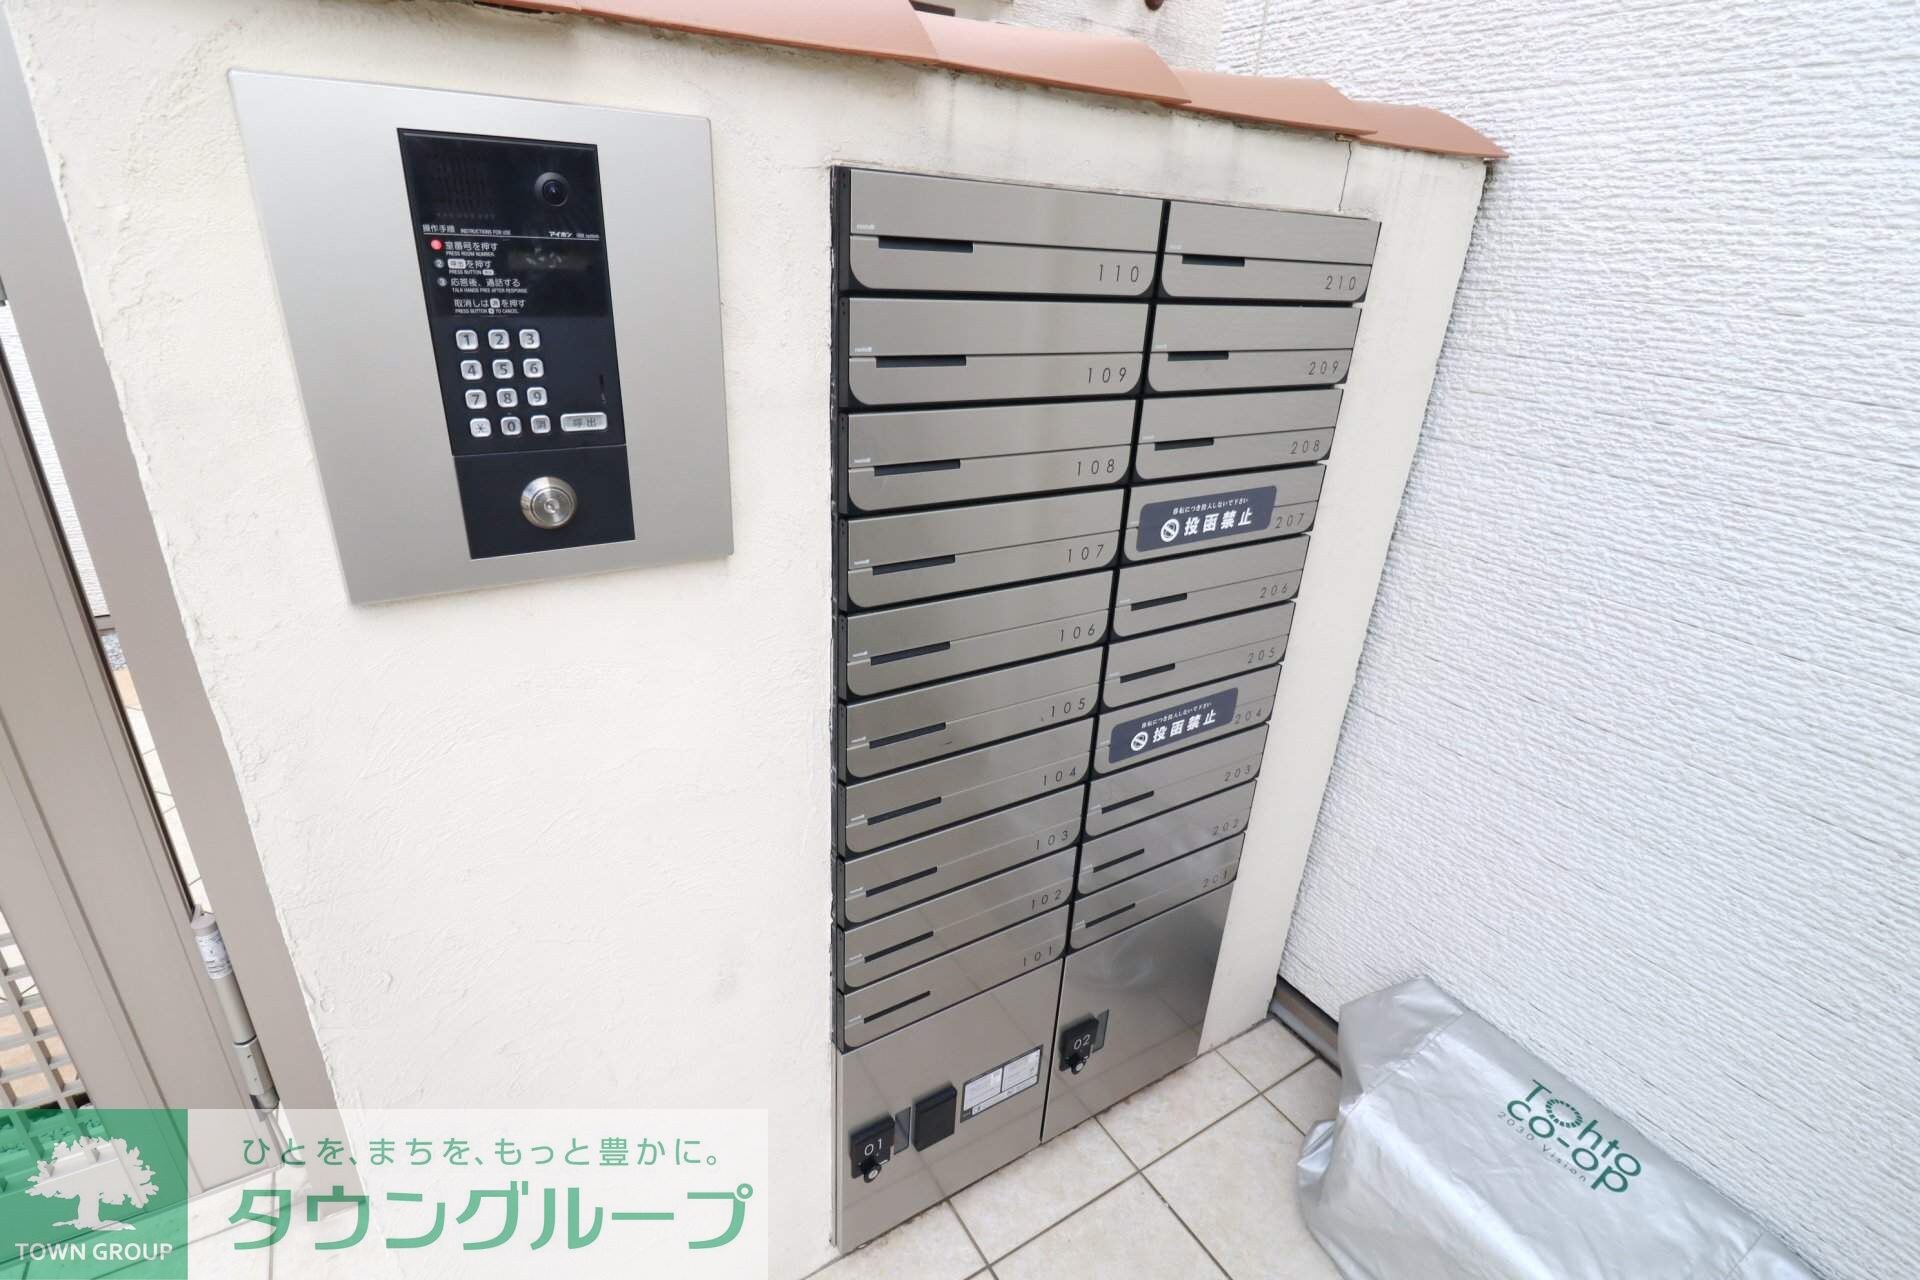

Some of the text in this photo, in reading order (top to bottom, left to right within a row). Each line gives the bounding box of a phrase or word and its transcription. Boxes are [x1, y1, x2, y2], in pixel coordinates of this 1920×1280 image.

[1098, 264, 1140, 283] 110
[1325, 275, 1357, 291] 210
[495, 334, 503, 345] 2
[527, 333, 535, 344] 3
[468, 363, 538, 376] 4 5 6
[1087, 366, 1127, 384] 109
[1308, 361, 1339, 376] 209
[472, 391, 542, 405] 7 8 9
[507, 421, 516, 432] 0
[1290, 439, 1320, 455] 208
[1077, 458, 1115, 477] 108
[1183, 506, 1253, 537] 投函禁止
[1275, 512, 1305, 529] 207
[1068, 544, 1104, 563] 107
[1259, 583, 1288, 599] 206
[1059, 623, 1095, 642] 106
[1247, 647, 1275, 664] 205
[1051, 698, 1086, 718] 105
[1235, 708, 1262, 725] 204
[1152, 709, 1217, 744] 投函禁止
[1043, 767, 1077, 786] 104
[1224, 765, 1252, 782] 203
[1212, 818, 1240, 836] 202
[1036, 830, 1069, 850] 103
[1202, 869, 1228, 889] 201
[1031, 889, 1062, 910] 102
[1023, 945, 1052, 967] 101
[1073, 1034, 1091, 1050] 02
[864, 1138, 883, 1156] 01
